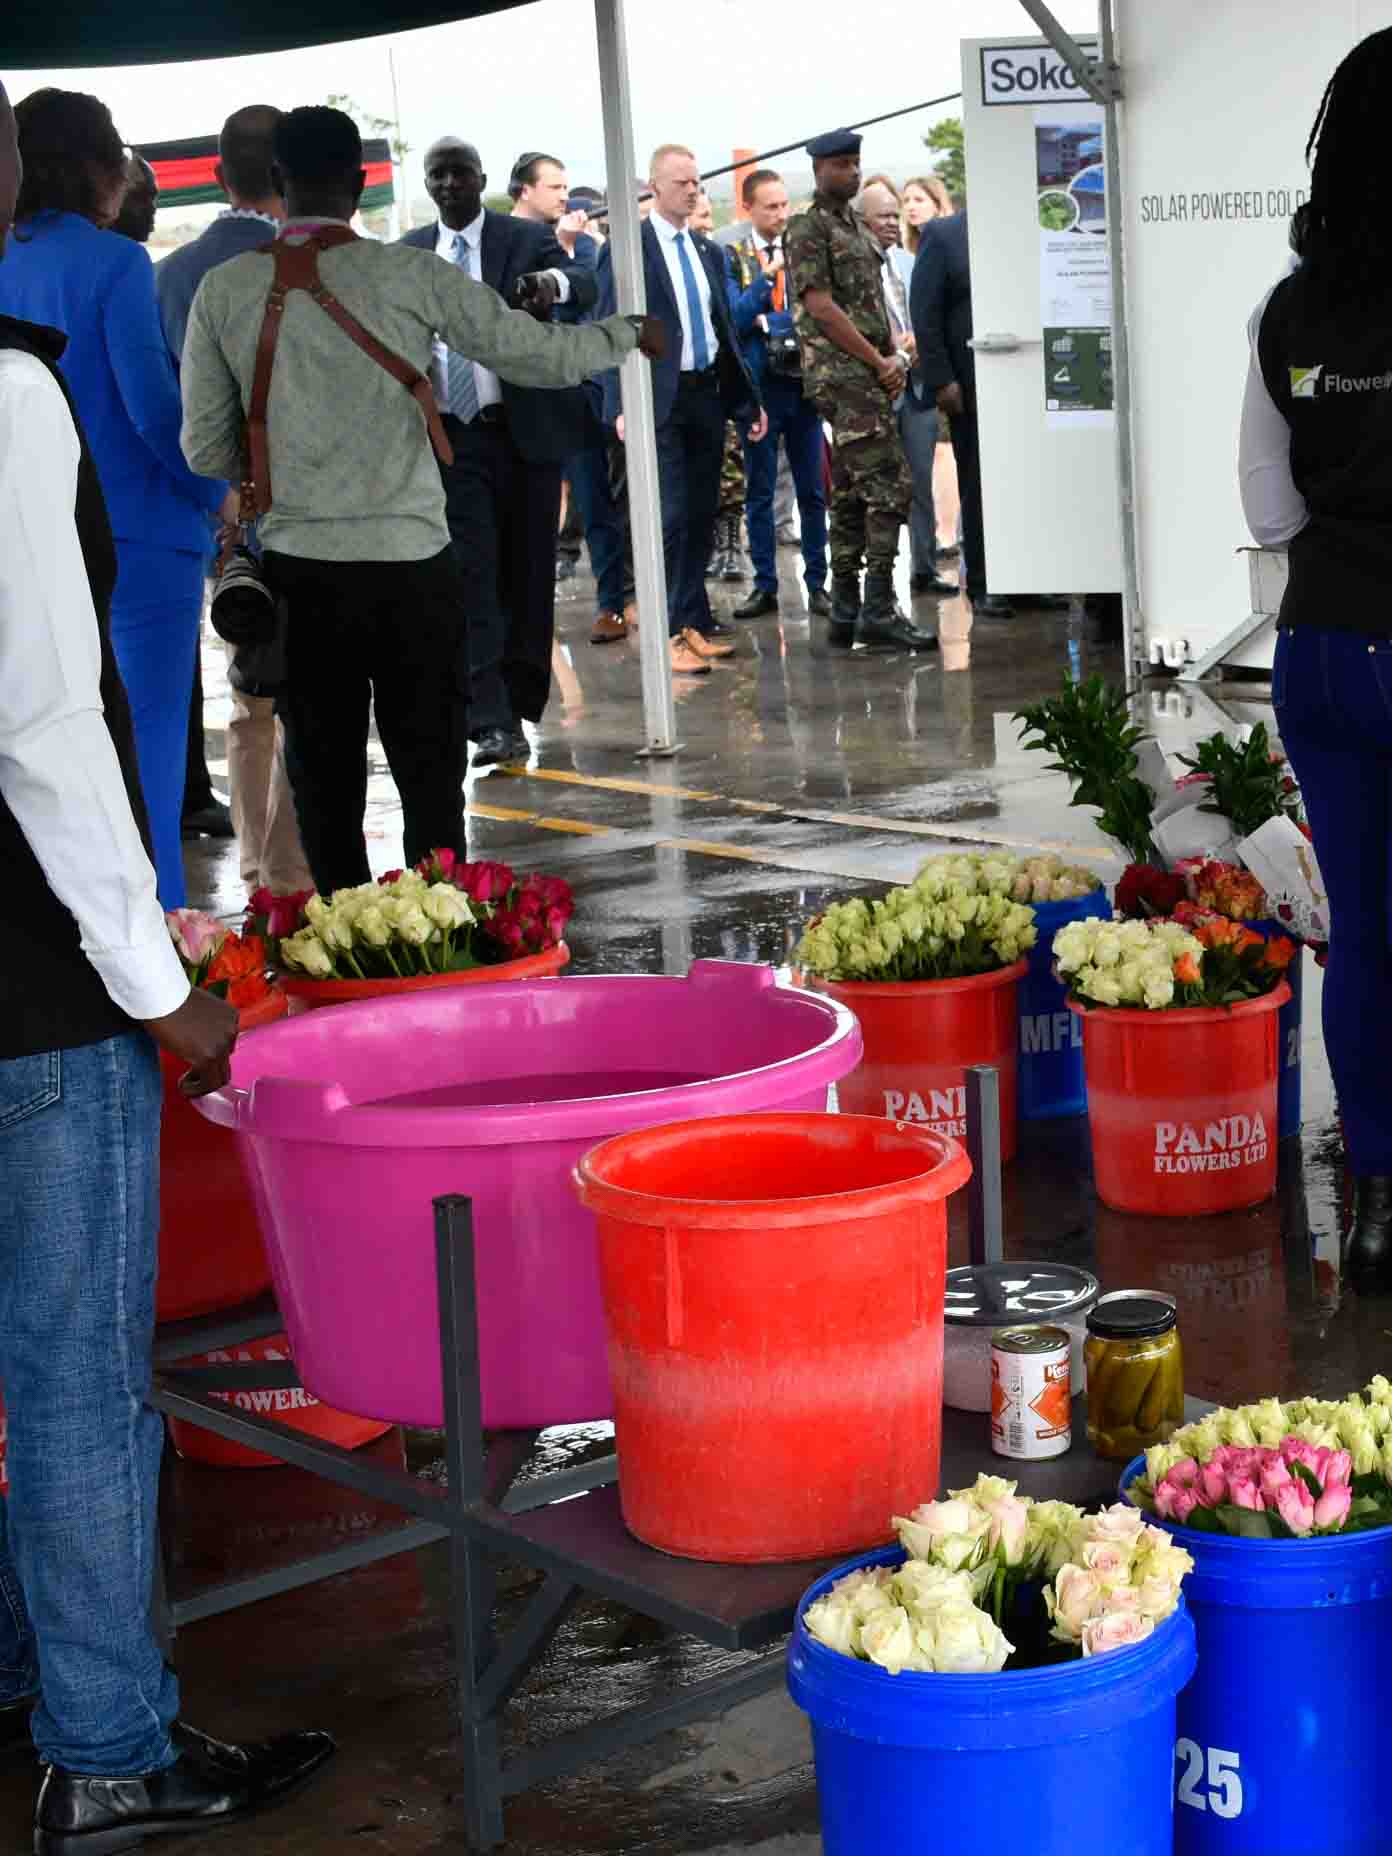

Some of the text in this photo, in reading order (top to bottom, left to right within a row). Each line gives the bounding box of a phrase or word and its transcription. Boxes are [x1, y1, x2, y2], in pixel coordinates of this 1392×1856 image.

[990, 56, 1098, 92] Soko
[1141, 195, 1188, 222] SOLAR
[1191, 191, 1263, 220] POWERED
[882, 1087, 966, 1120] PAN
[1154, 1112, 1267, 1154] PANDA
[1153, 1141, 1267, 1173] FLOWERS LTD
[1176, 1737, 1243, 1818] 25
